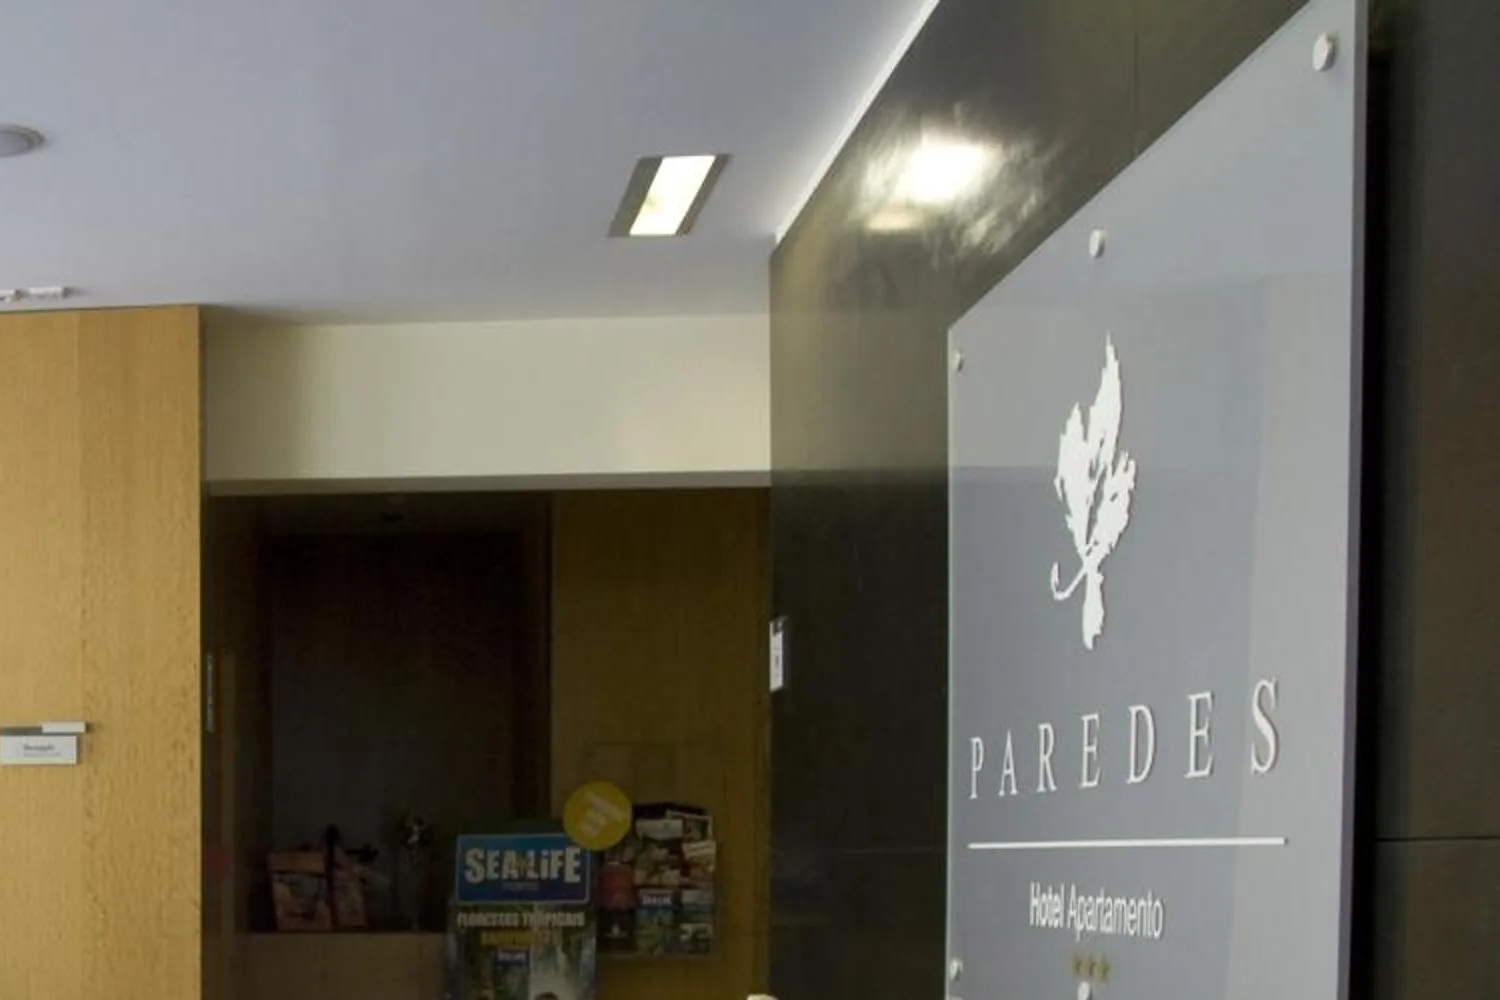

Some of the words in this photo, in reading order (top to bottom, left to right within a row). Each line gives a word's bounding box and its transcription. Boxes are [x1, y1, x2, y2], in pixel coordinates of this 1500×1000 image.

[968, 677, 1282, 800] PAREDES
[1029, 881, 1064, 929] Hotel
[1067, 883, 1165, 942] Apartamento
